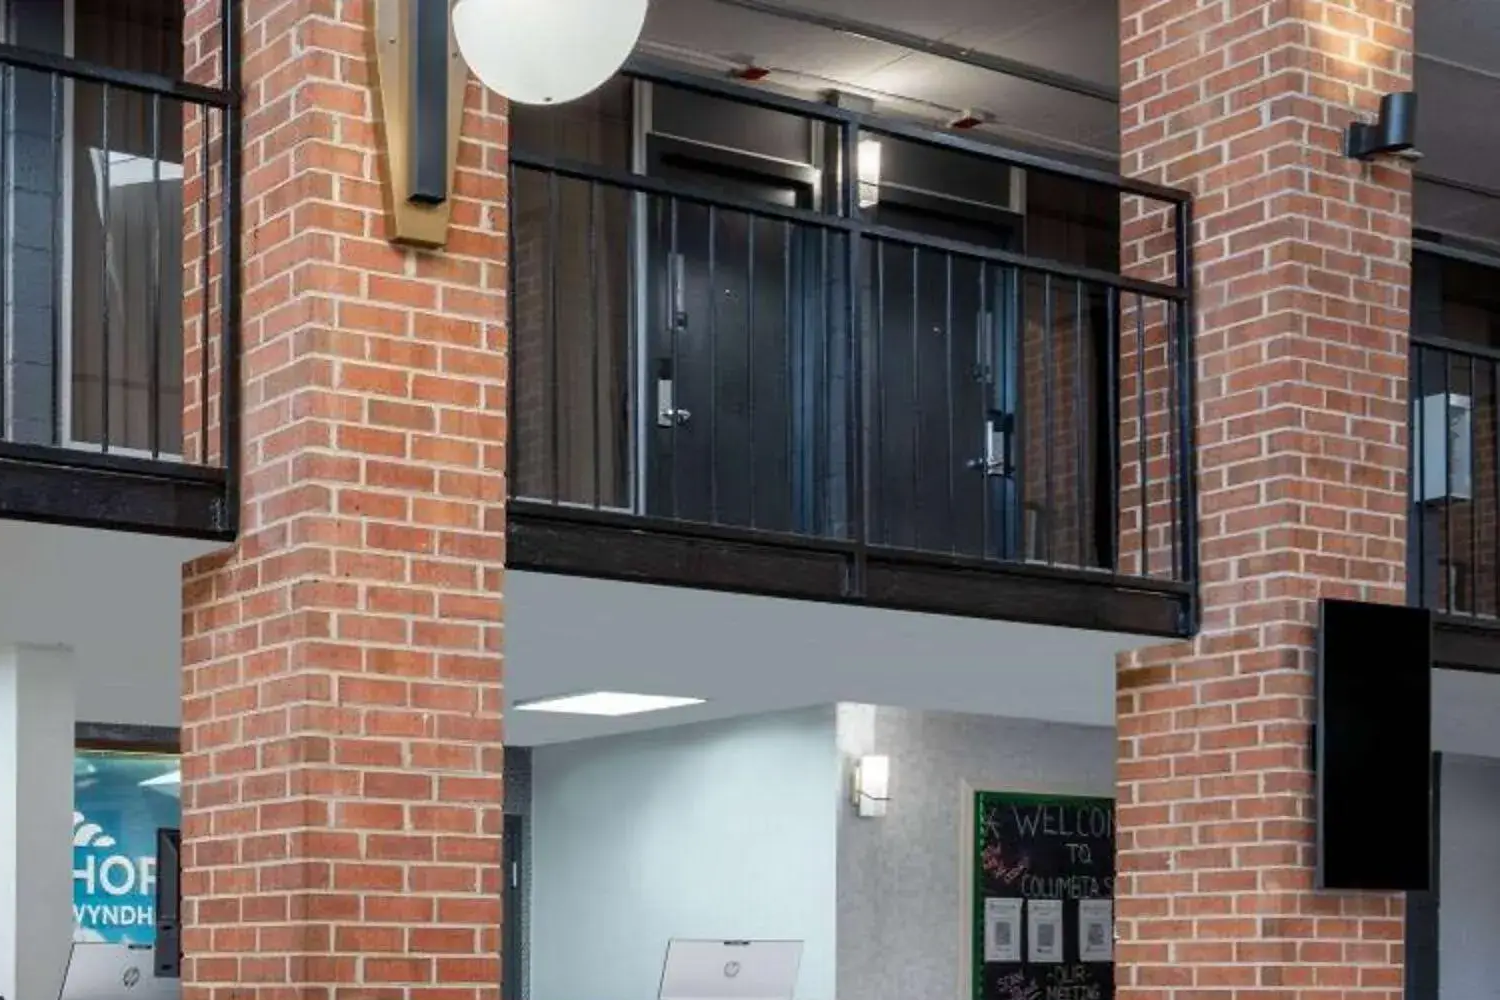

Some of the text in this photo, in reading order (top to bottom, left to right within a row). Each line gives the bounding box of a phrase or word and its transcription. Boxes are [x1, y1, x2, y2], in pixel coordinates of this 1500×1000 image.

[1012, 804, 1111, 839] WELCO
[1064, 843, 1093, 865] TO
[72, 904, 154, 925] YNDH
